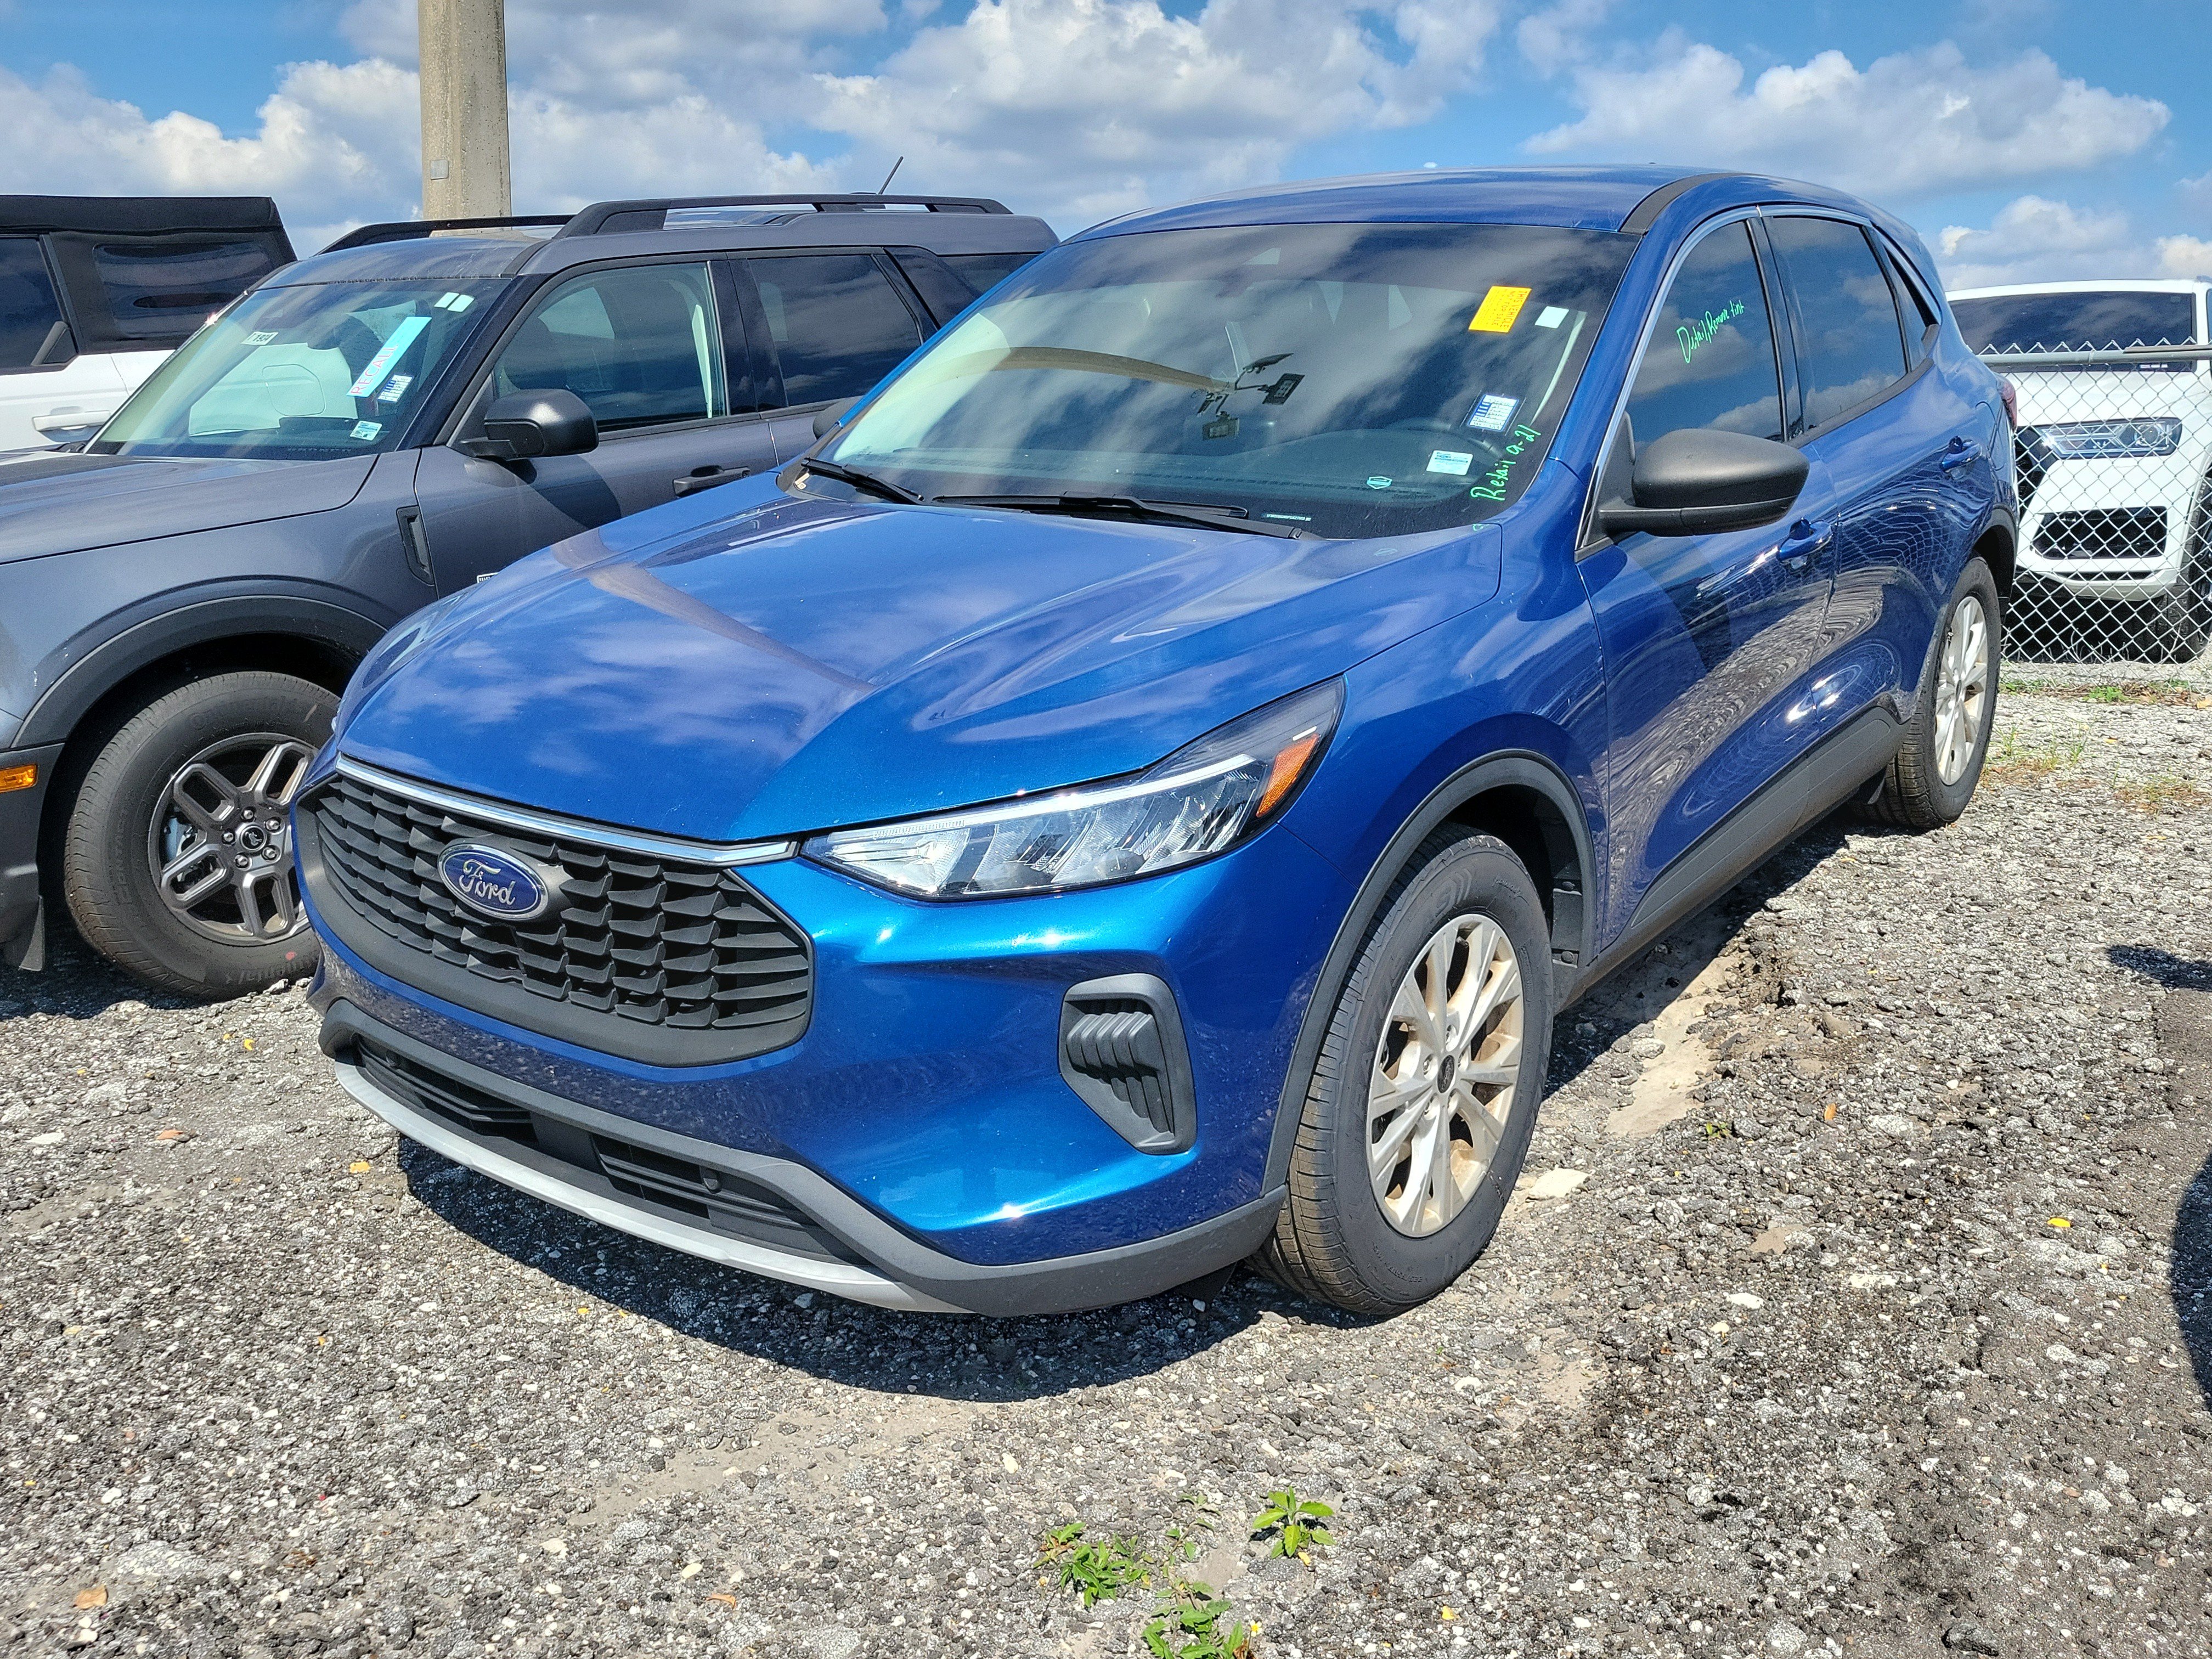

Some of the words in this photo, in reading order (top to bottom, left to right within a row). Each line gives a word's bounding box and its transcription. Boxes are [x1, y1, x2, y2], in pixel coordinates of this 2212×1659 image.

[1514, 290, 1528, 303] THIS
[1499, 304, 1520, 328] VEHICLE
[350, 344, 399, 394] RECALL
[458, 858, 517, 906] Ford
